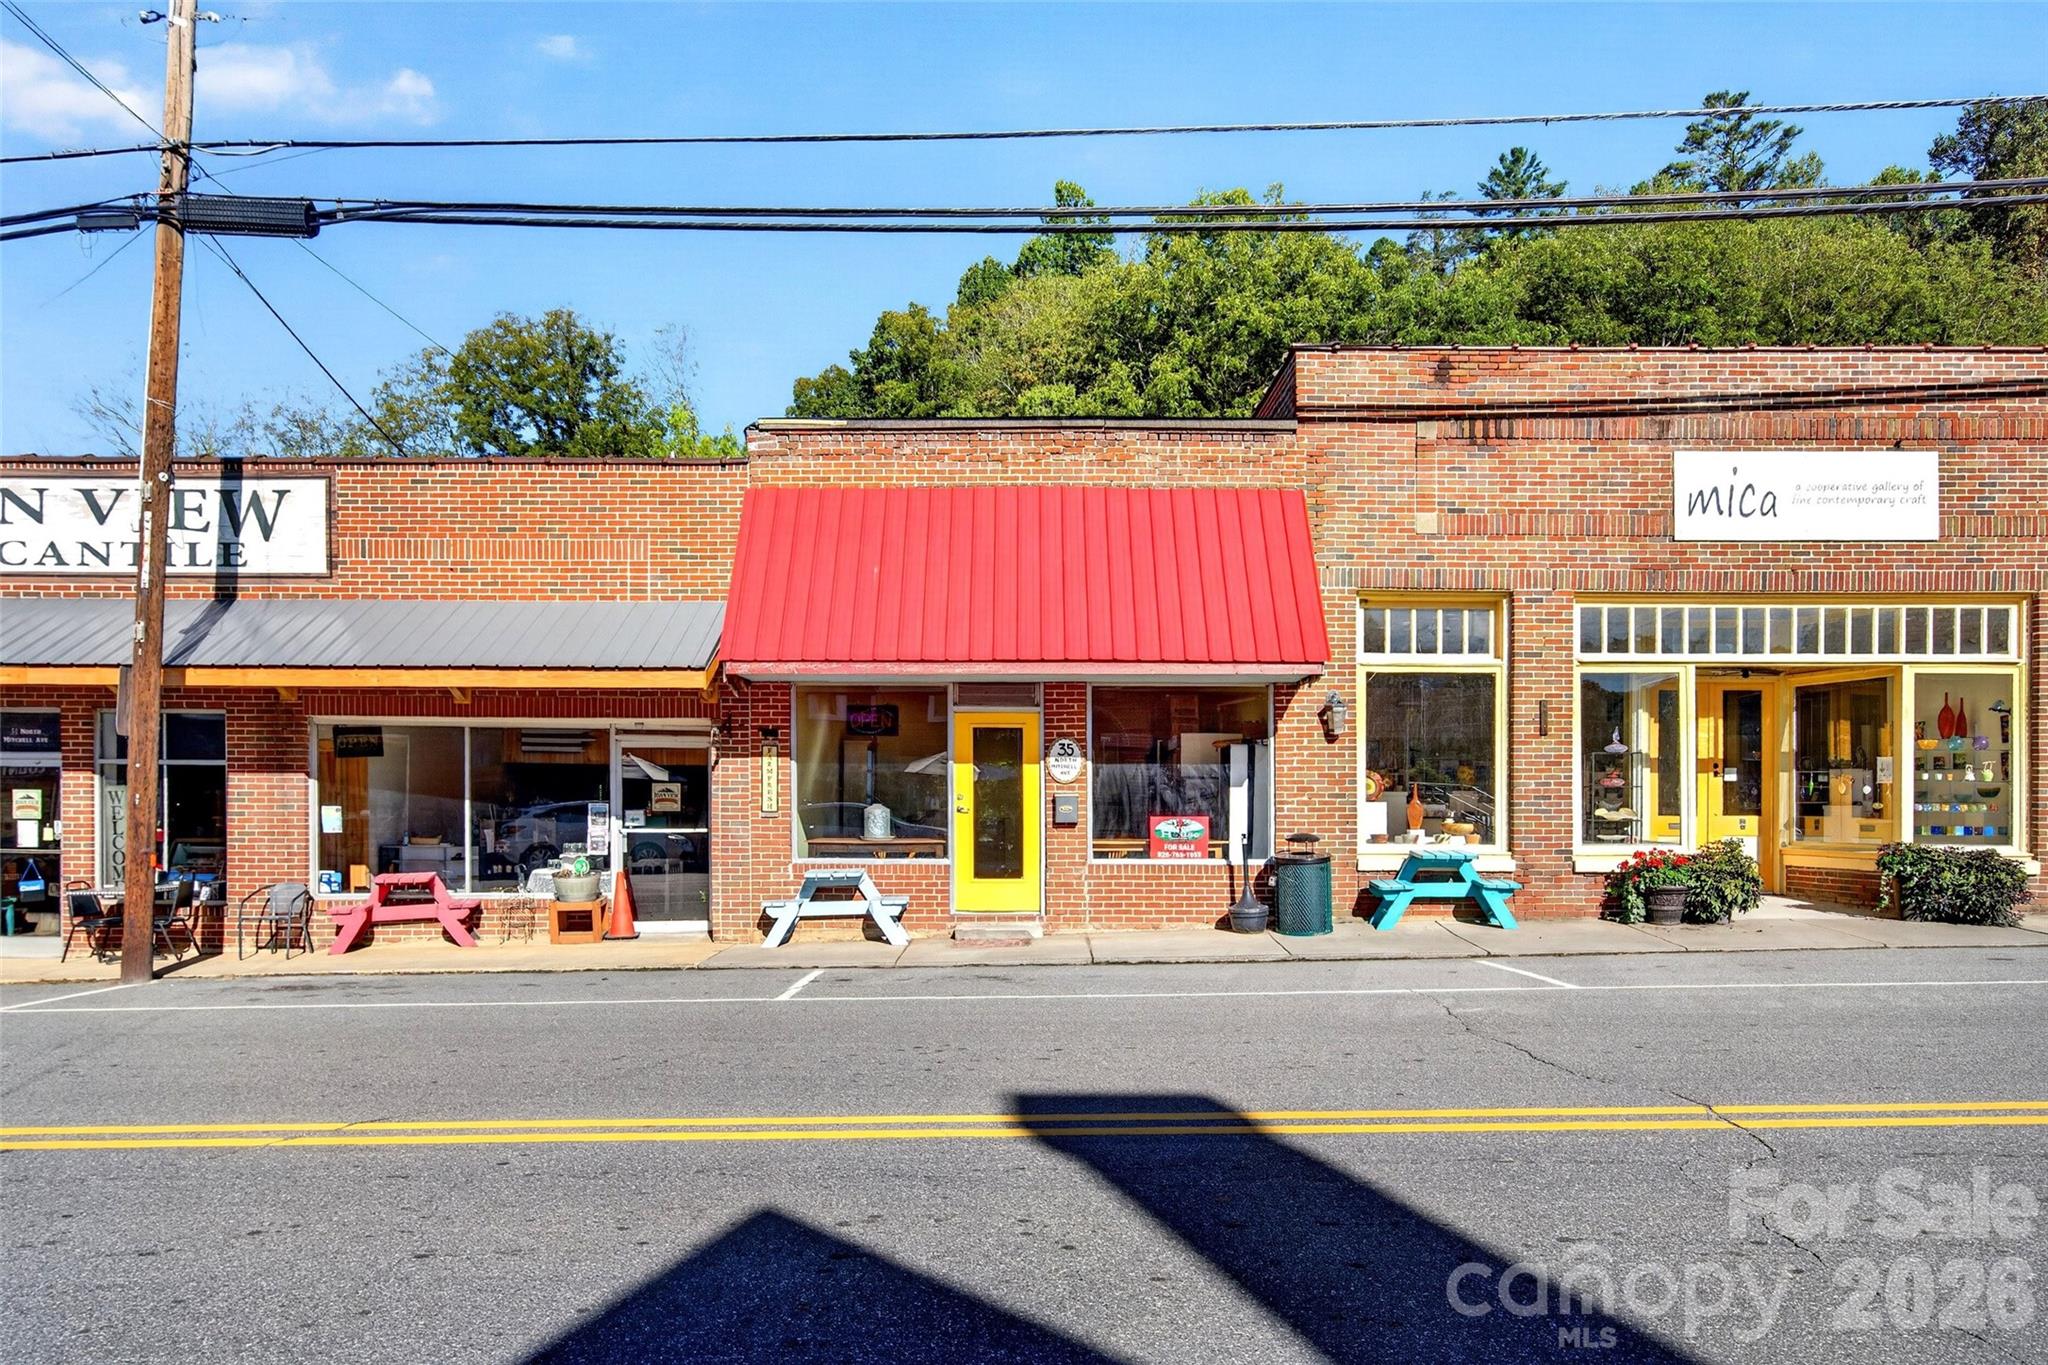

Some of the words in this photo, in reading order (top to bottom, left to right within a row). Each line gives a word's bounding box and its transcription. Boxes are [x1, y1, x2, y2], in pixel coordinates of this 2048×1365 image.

[1688, 467, 1778, 518] mica
[1872, 481, 1909, 494] gallery
[1913, 479, 1925, 491] of
[1817, 495, 1895, 507] contemporary
[1899, 493, 1927, 504] craft
[74, 487, 291, 542] VEW
[1057, 743, 1075, 757] 35
